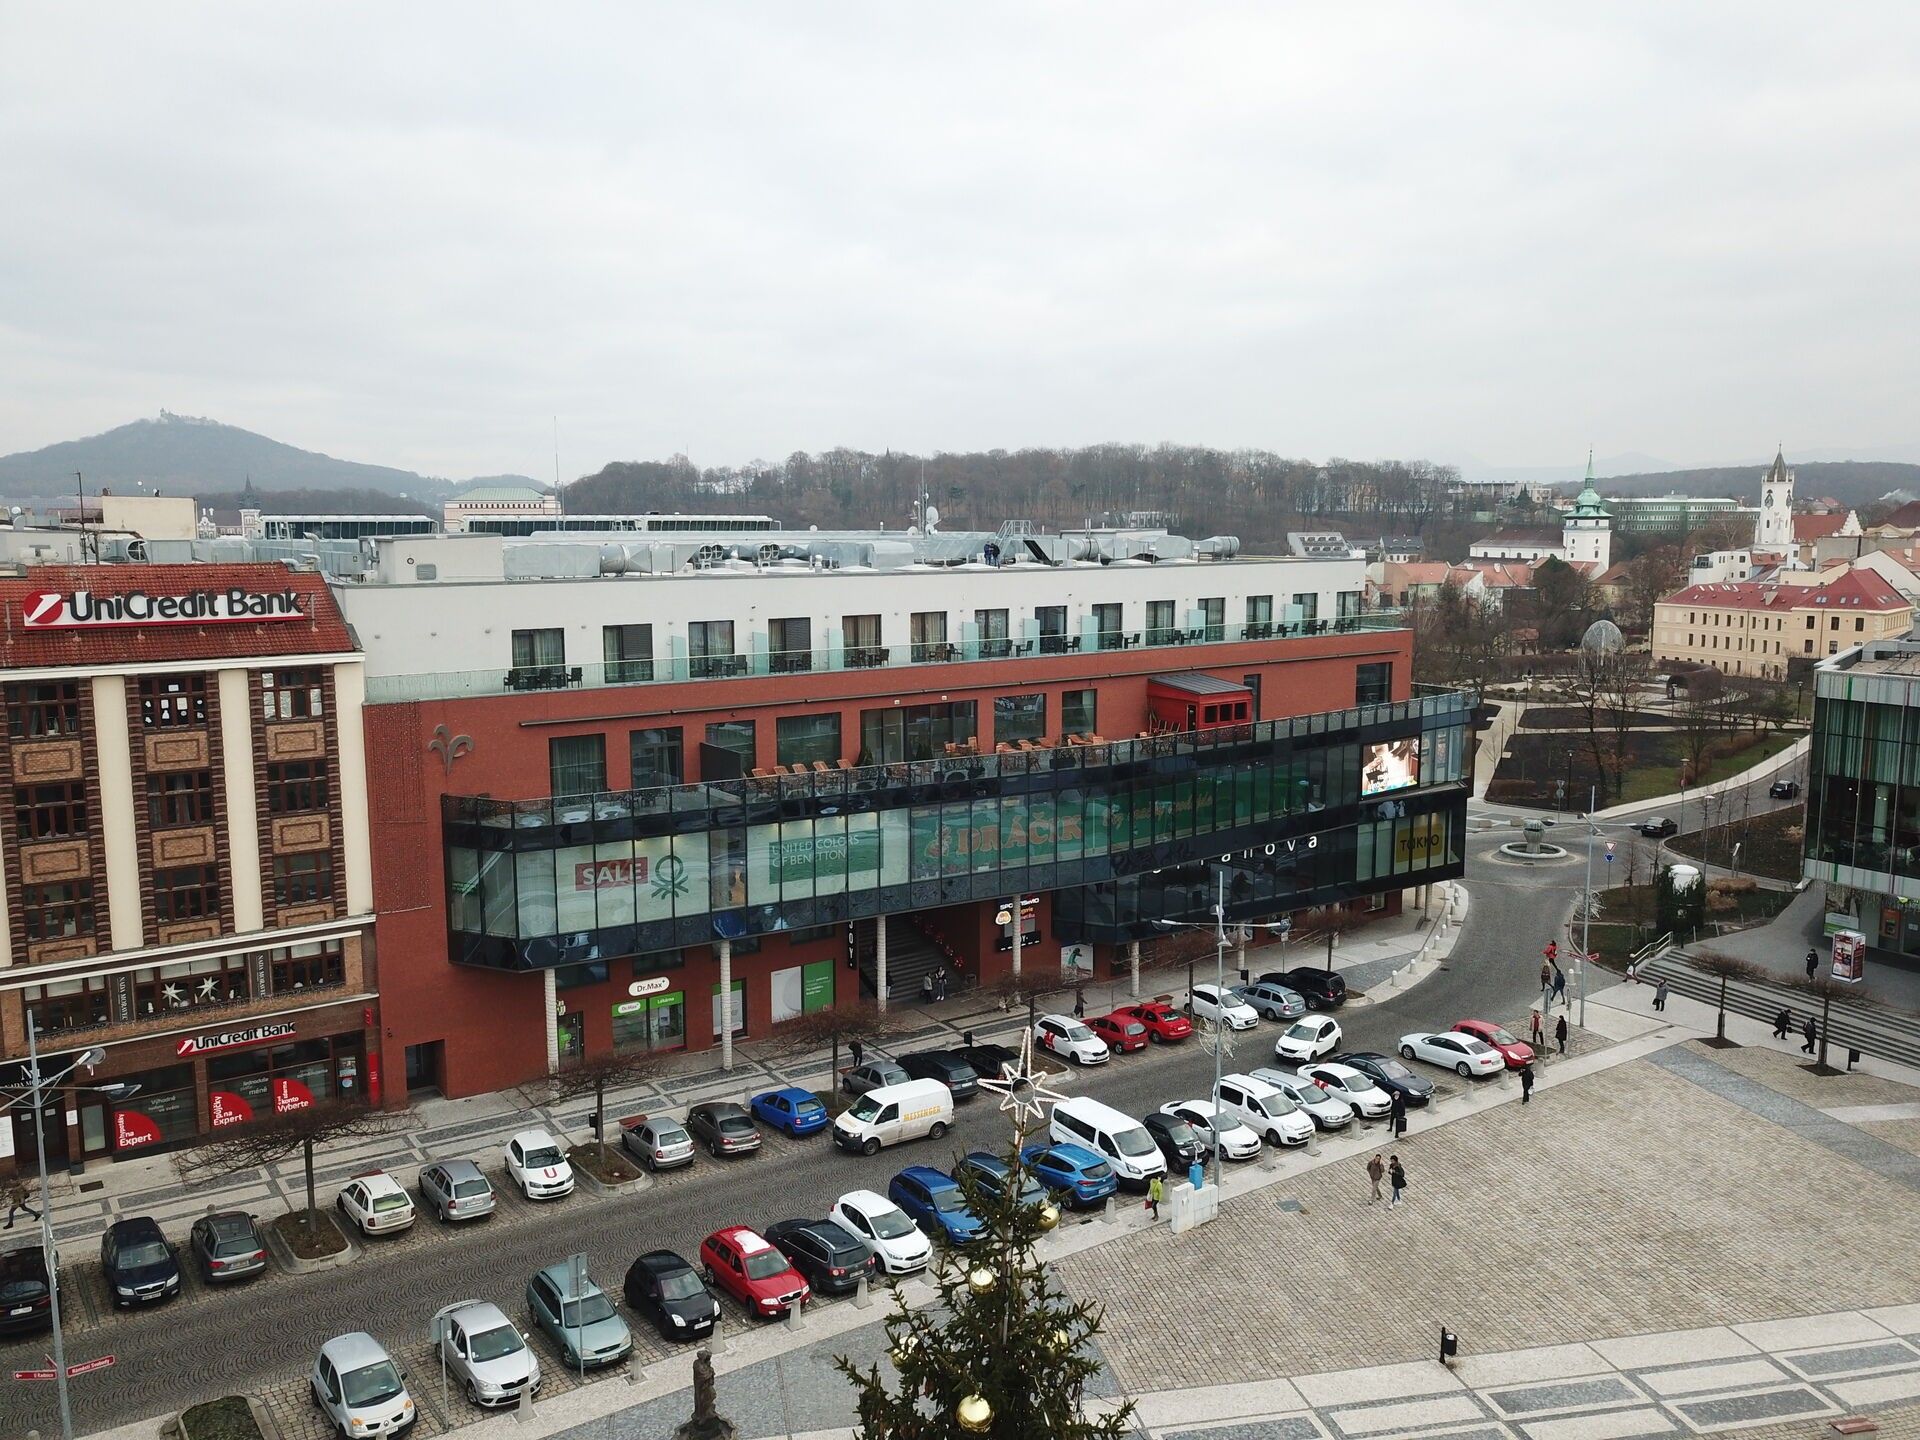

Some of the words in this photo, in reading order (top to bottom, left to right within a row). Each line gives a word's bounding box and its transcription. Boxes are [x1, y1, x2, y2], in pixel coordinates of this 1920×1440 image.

[69, 589, 219, 621] UniCredit
[227, 587, 303, 616] Bank
[772, 841, 813, 855] UNITED
[816, 835, 860, 849] COLORS
[772, 856, 788, 867] OF
[790, 849, 846, 865] BENTTON
[582, 863, 642, 886] SALE
[195, 1026, 259, 1050] UniCredit
[262, 1021, 296, 1039] Bank
[277, 1100, 309, 1112] Vyberte
[903, 1105, 942, 1121] MESSENGER
[213, 1114, 243, 1126] Expert
[120, 1133, 152, 1147] Expert
